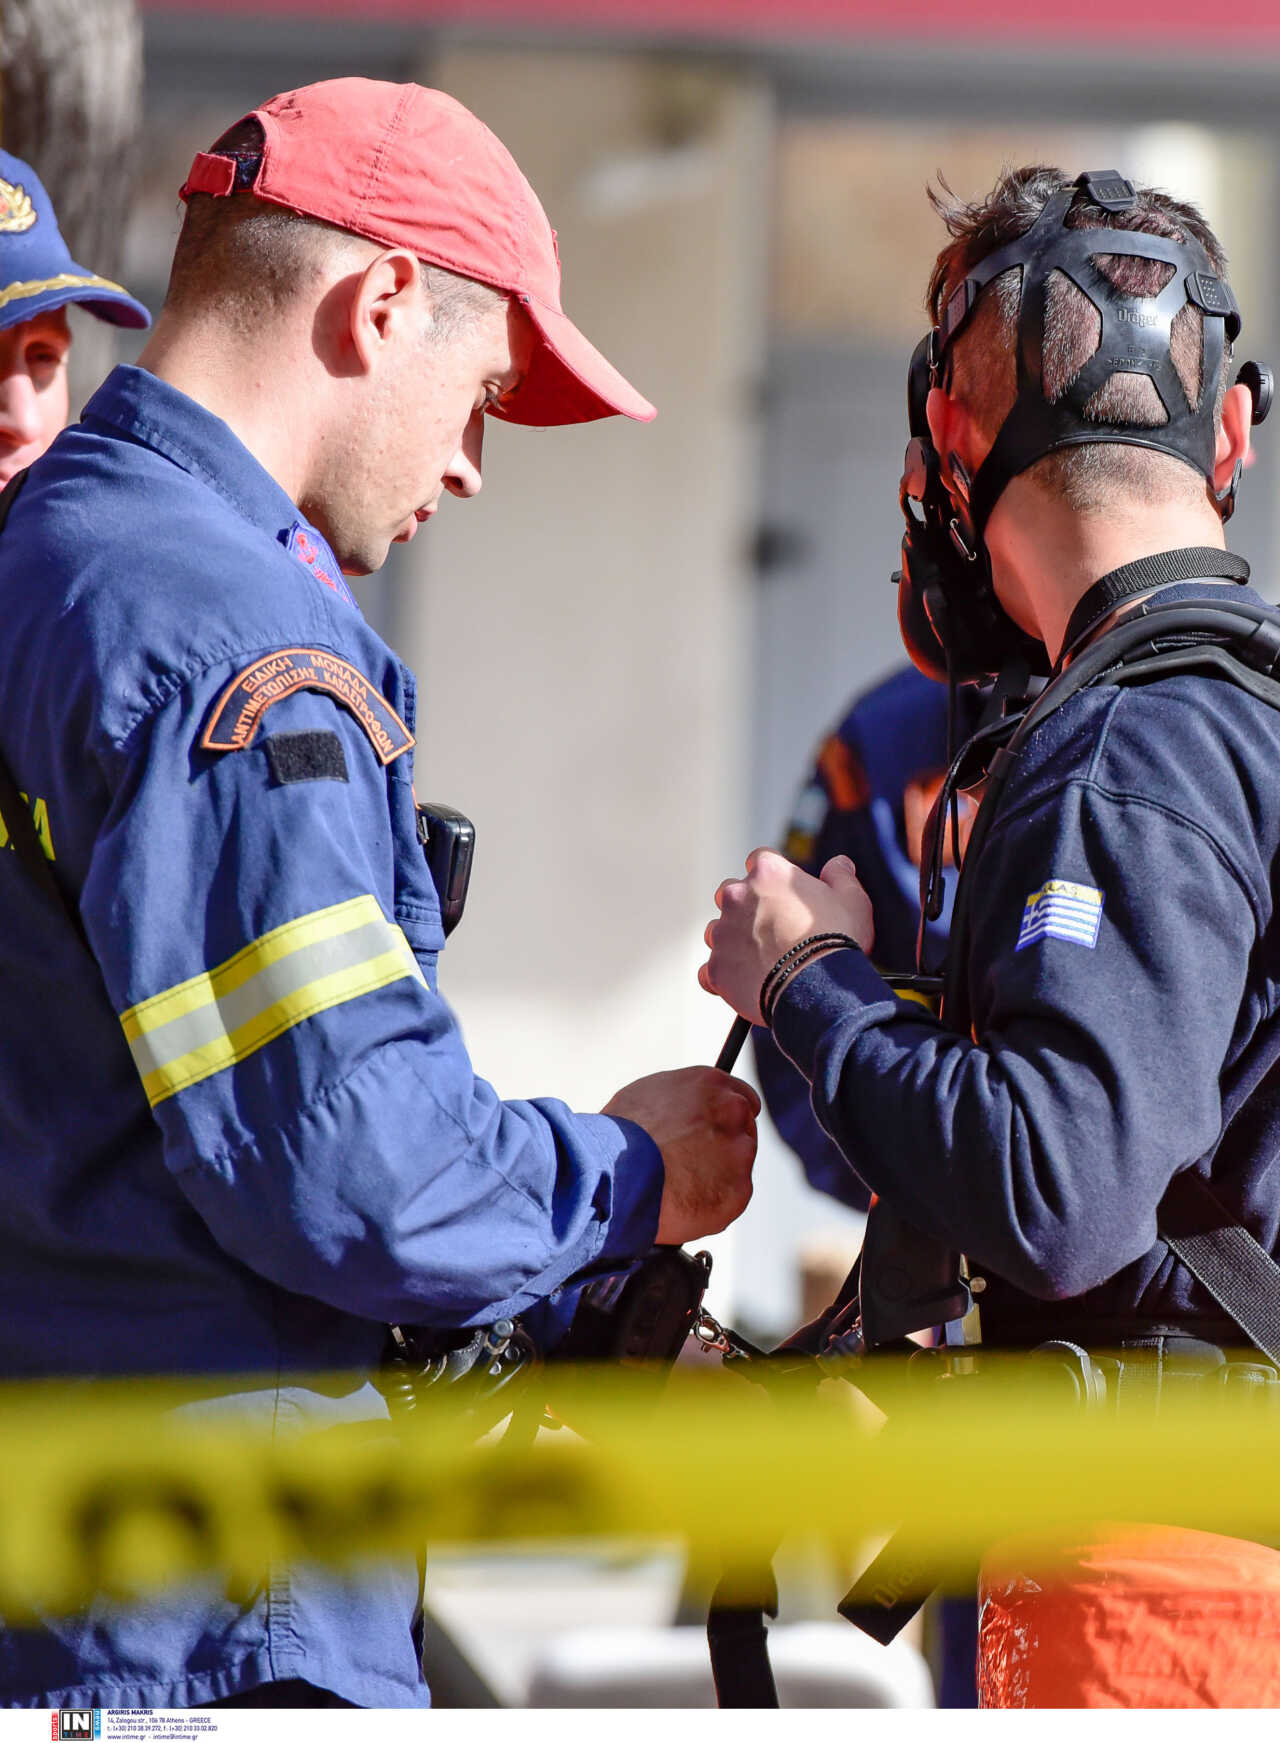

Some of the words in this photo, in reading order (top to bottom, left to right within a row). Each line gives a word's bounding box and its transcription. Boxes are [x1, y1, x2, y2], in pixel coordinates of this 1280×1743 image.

[230, 667, 318, 744] ΑΝΤΙΜΕΤΩΠΙΣΗΣ
[324, 671, 395, 753] ΚΑΤΑΣΤΡΟΦΩΝ
[241, 655, 293, 693] ΕΙΔΙΚΗ
[310, 655, 368, 701] ΜΟΝΑΔΑ
